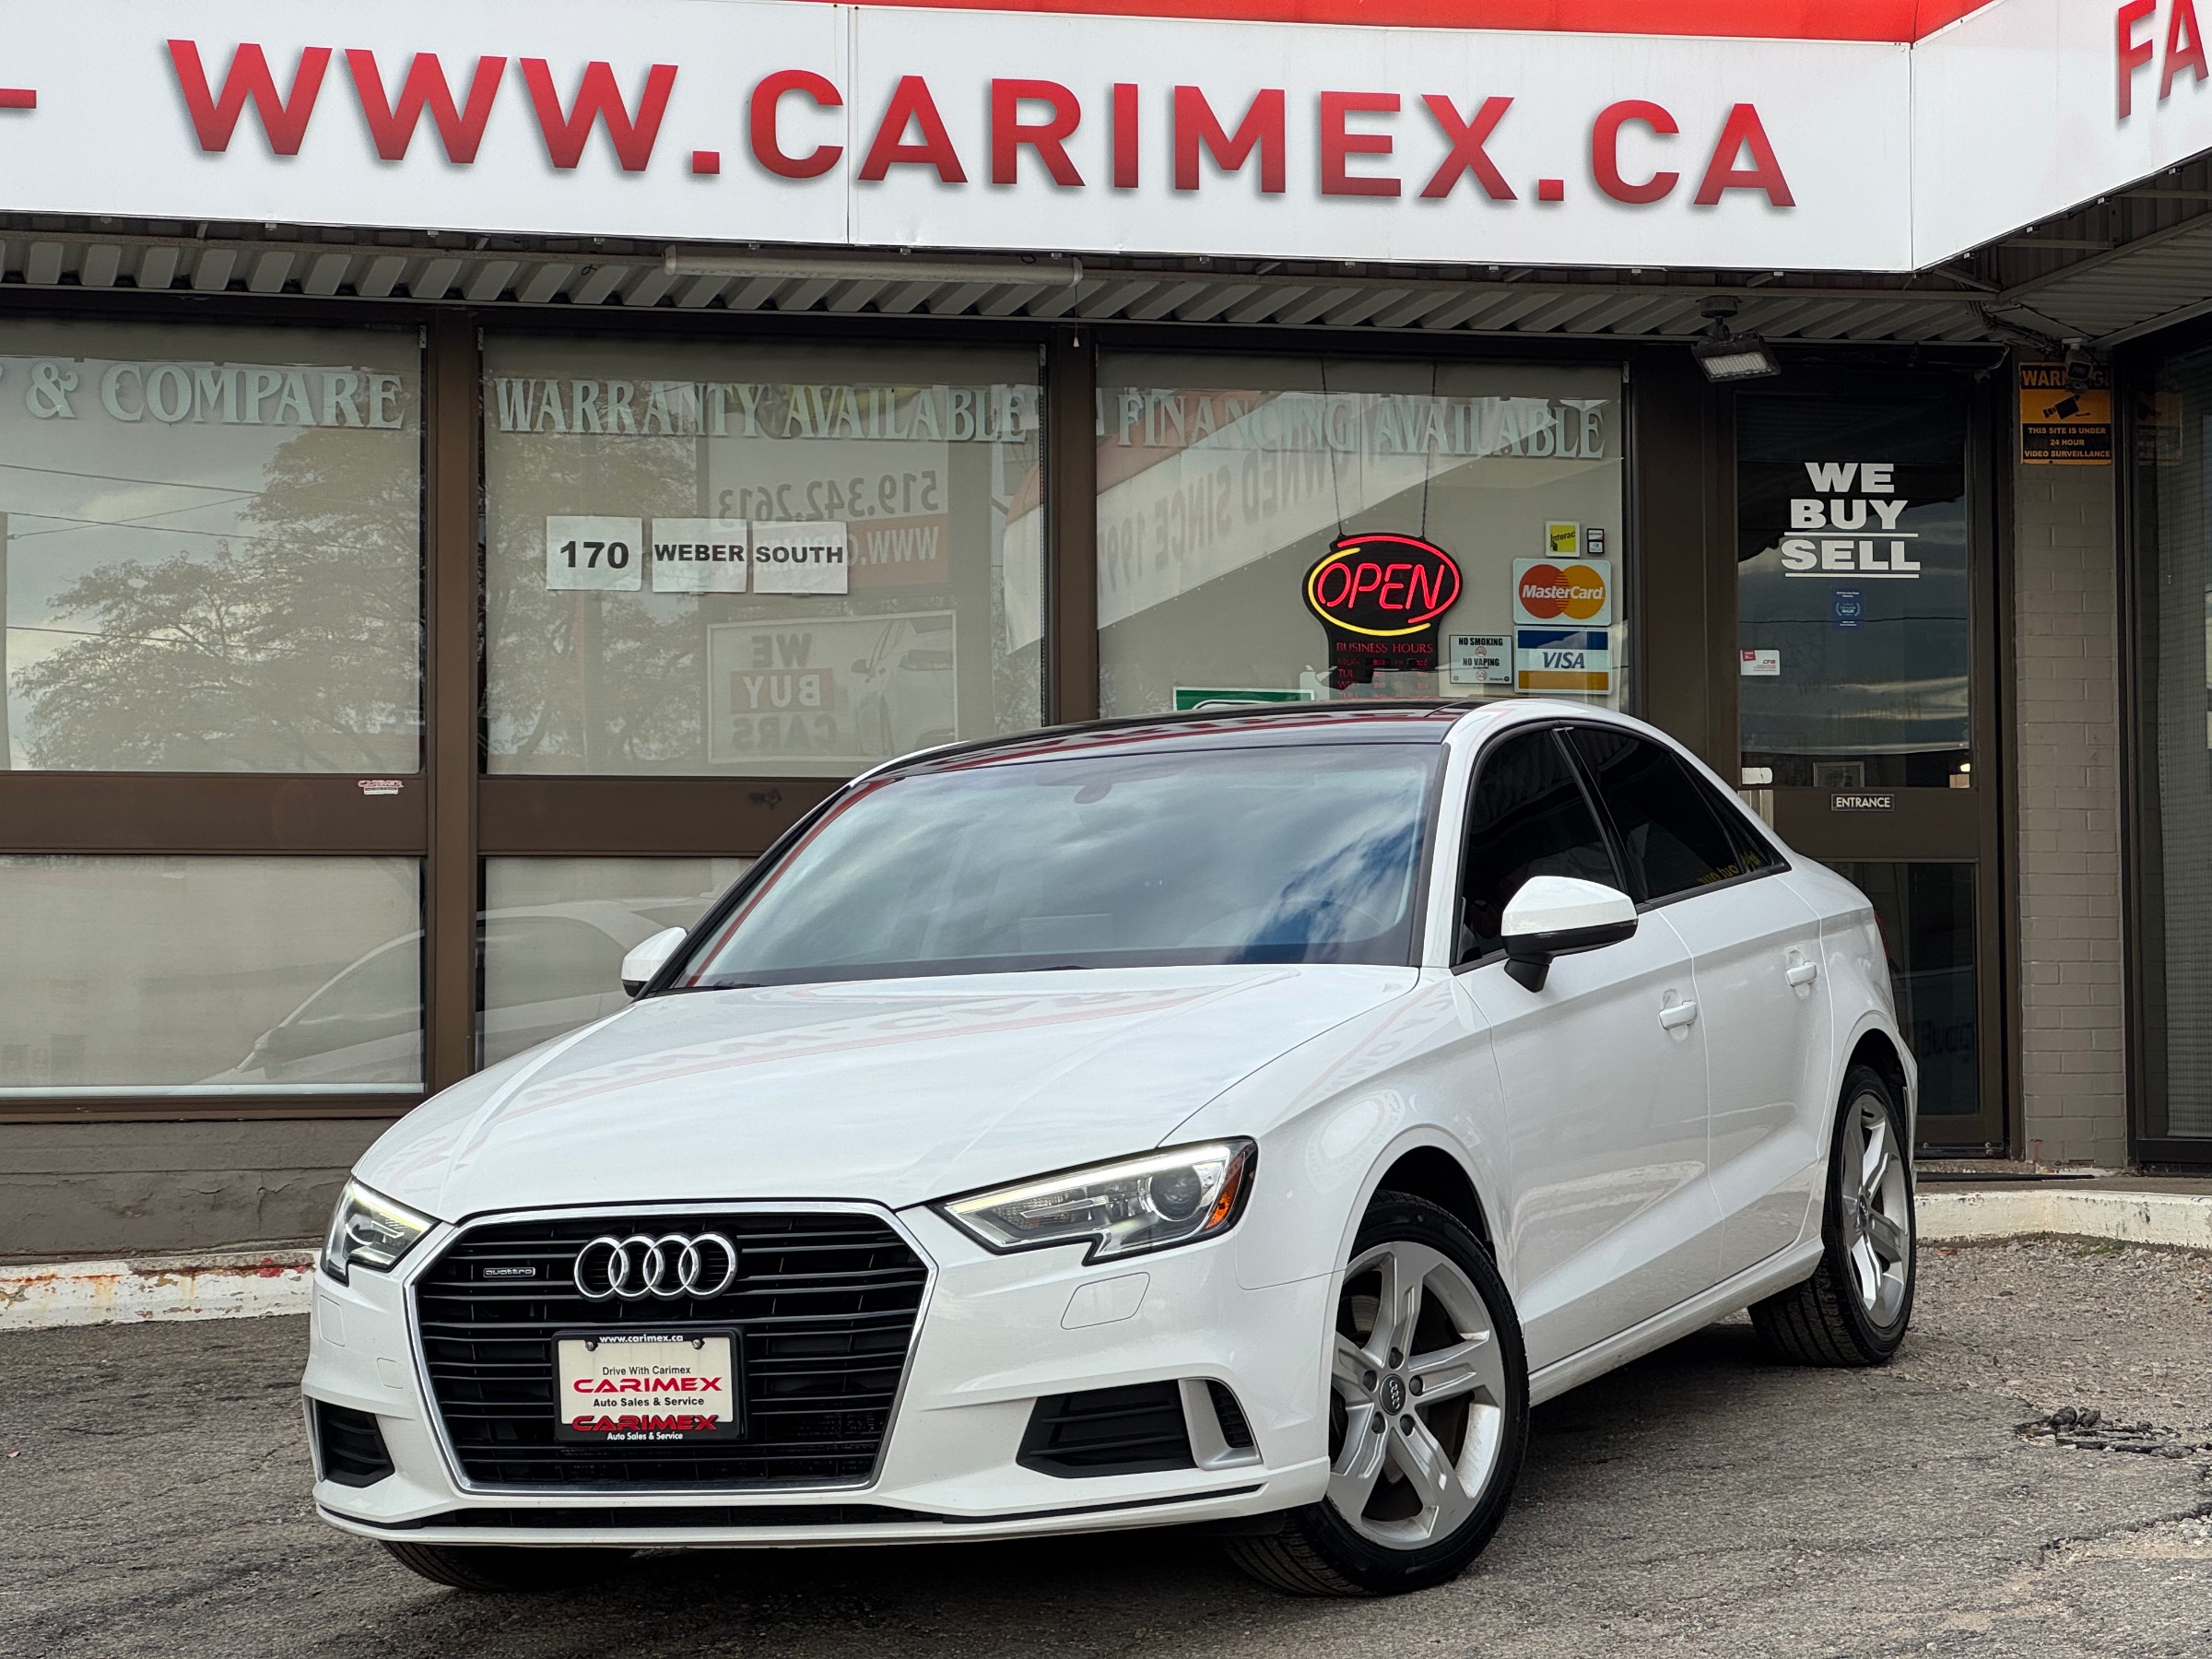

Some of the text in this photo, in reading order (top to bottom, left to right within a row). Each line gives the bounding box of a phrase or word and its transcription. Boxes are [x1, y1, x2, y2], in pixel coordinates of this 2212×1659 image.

[166, 39, 1796, 207] WWW.CARIMEX.CA
[26, 361, 405, 429] & COMPARE
[493, 378, 1027, 442] WARRANTY AVAILABLE
[1116, 393, 1606, 459] FINANCING AVAILABLE
[1805, 462, 1895, 493] WE
[1790, 499, 1909, 530] BUY
[1550, 530, 1576, 543] Interac
[559, 540, 843, 570] 170 WEBER SOUTH
[1781, 539, 1921, 571] SELL
[1317, 562, 1444, 610] OPEN
[1522, 584, 1604, 600] MasterCard
[1336, 641, 1433, 653] BUSINESS HOURS
[1458, 637, 1503, 646] NO SMOKING
[1463, 658, 1500, 666] NO VAPING
[1543, 652, 1585, 669] VISA
[1836, 796, 1891, 808] ENTRANCE
[485, 1268, 533, 1277] quattro
[599, 1334, 684, 1343] www.carimex.ca
[602, 1365, 691, 1376] Drive With Carimex
[573, 1377, 723, 1394] CARIMEX
[593, 1396, 705, 1407] Auto Sales & Service
[571, 1414, 719, 1431] CARIMEX
[606, 1431, 684, 1441] Auto Sales & Service
